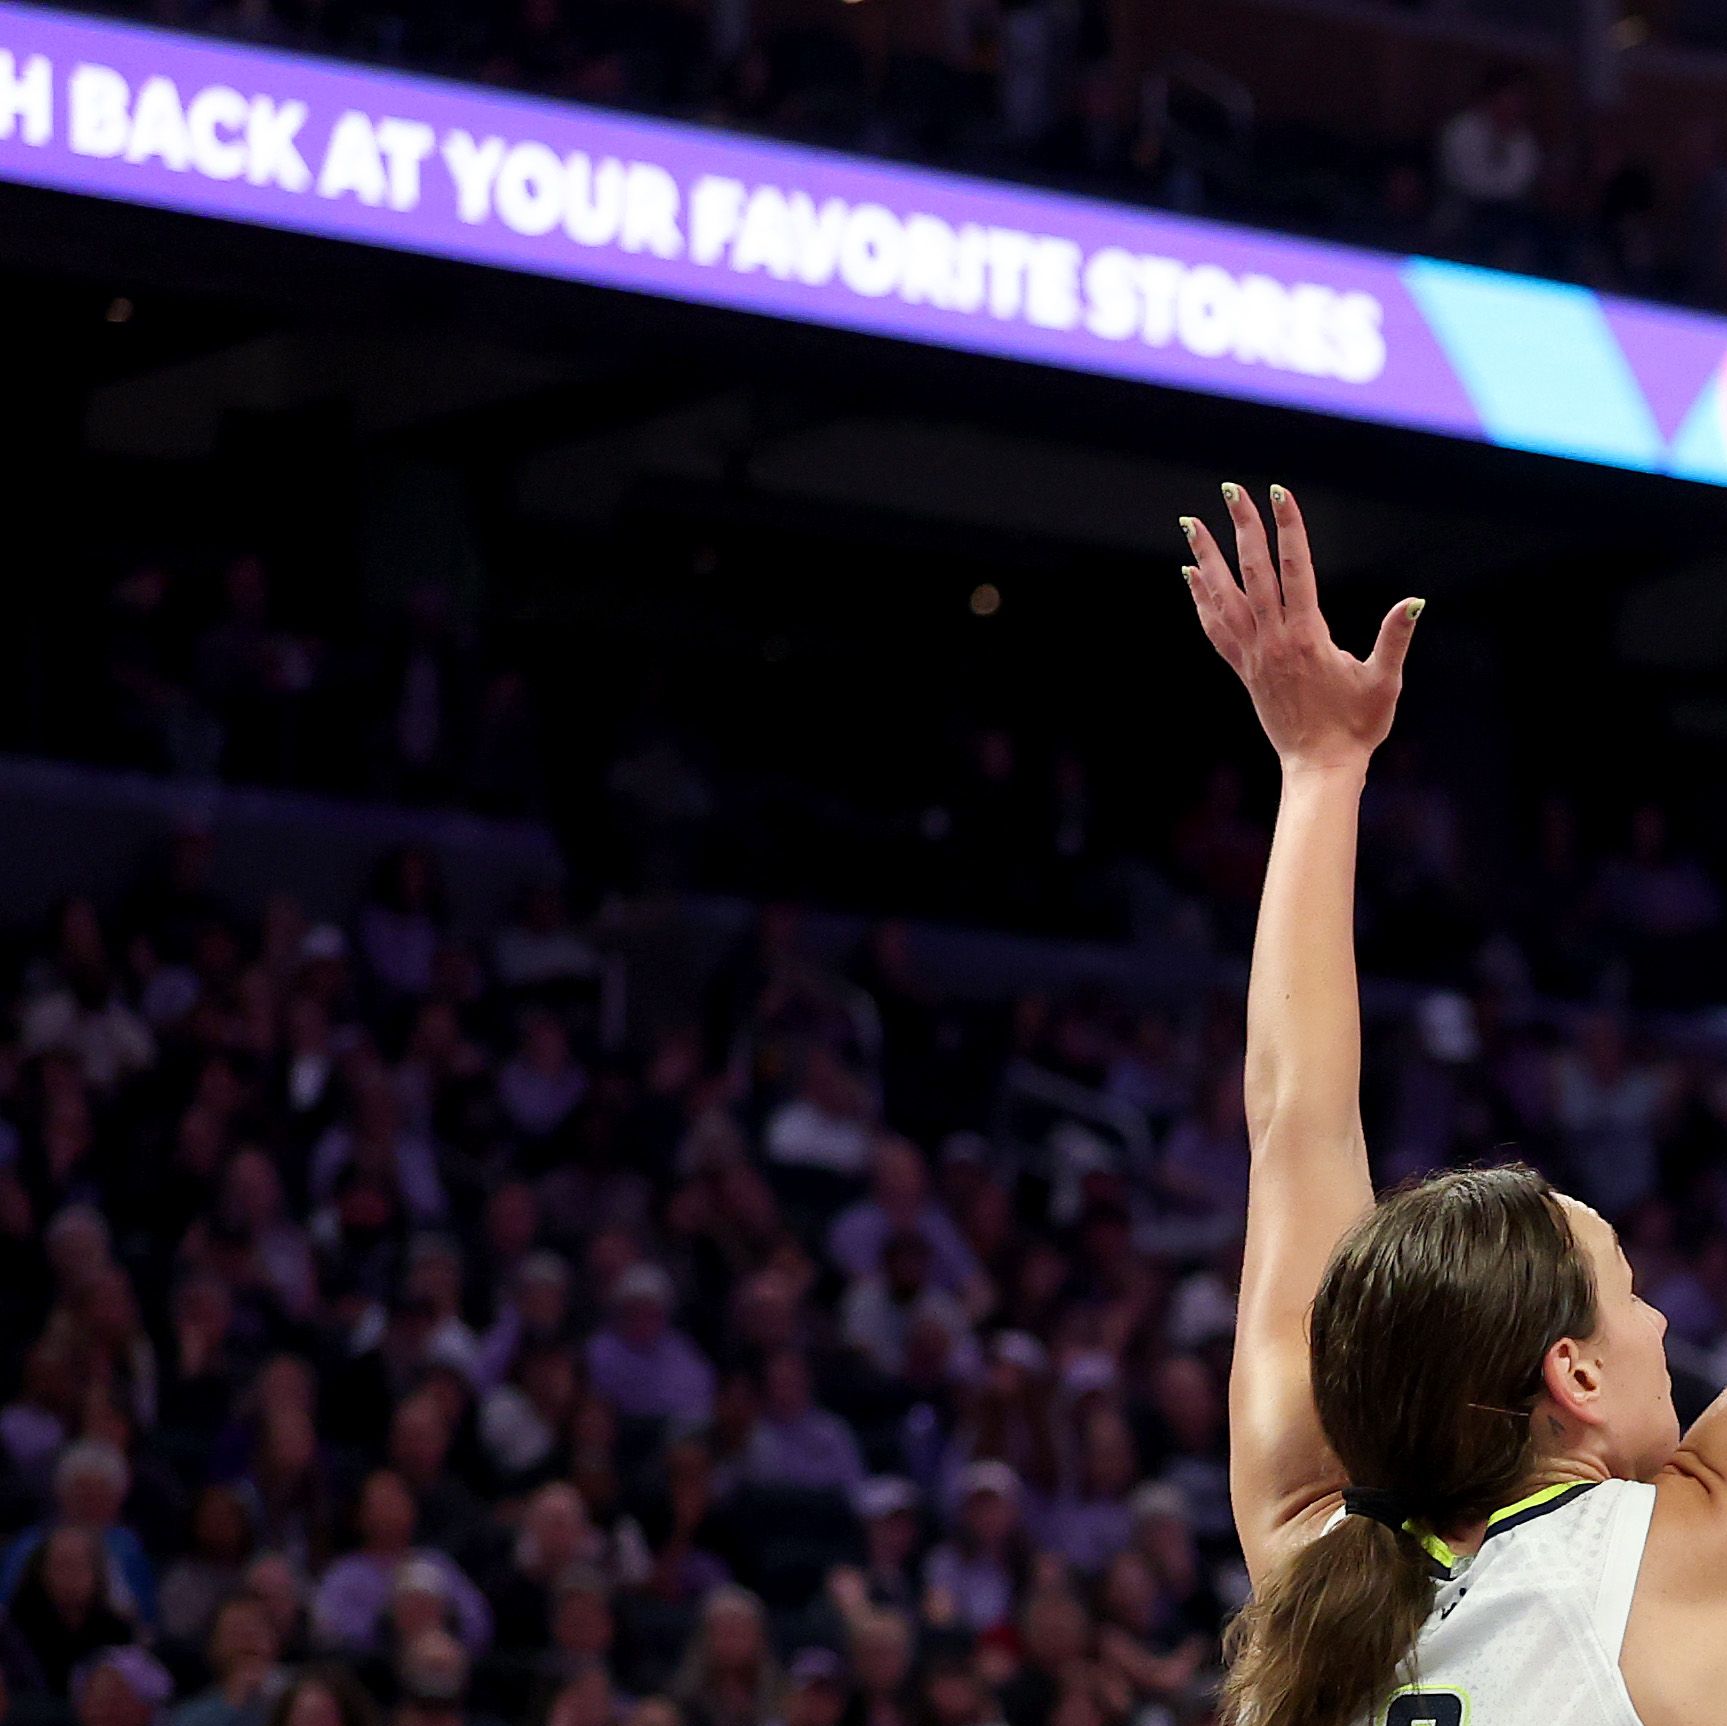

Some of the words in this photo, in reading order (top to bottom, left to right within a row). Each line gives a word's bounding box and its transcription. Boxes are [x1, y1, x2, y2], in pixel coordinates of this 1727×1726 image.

[70, 66, 308, 191] BACK
[320, 114, 434, 209] AT
[443, 132, 681, 258] YOUR
[691, 177, 1084, 329] FAVORITE
[1086, 248, 1385, 383] STORES
